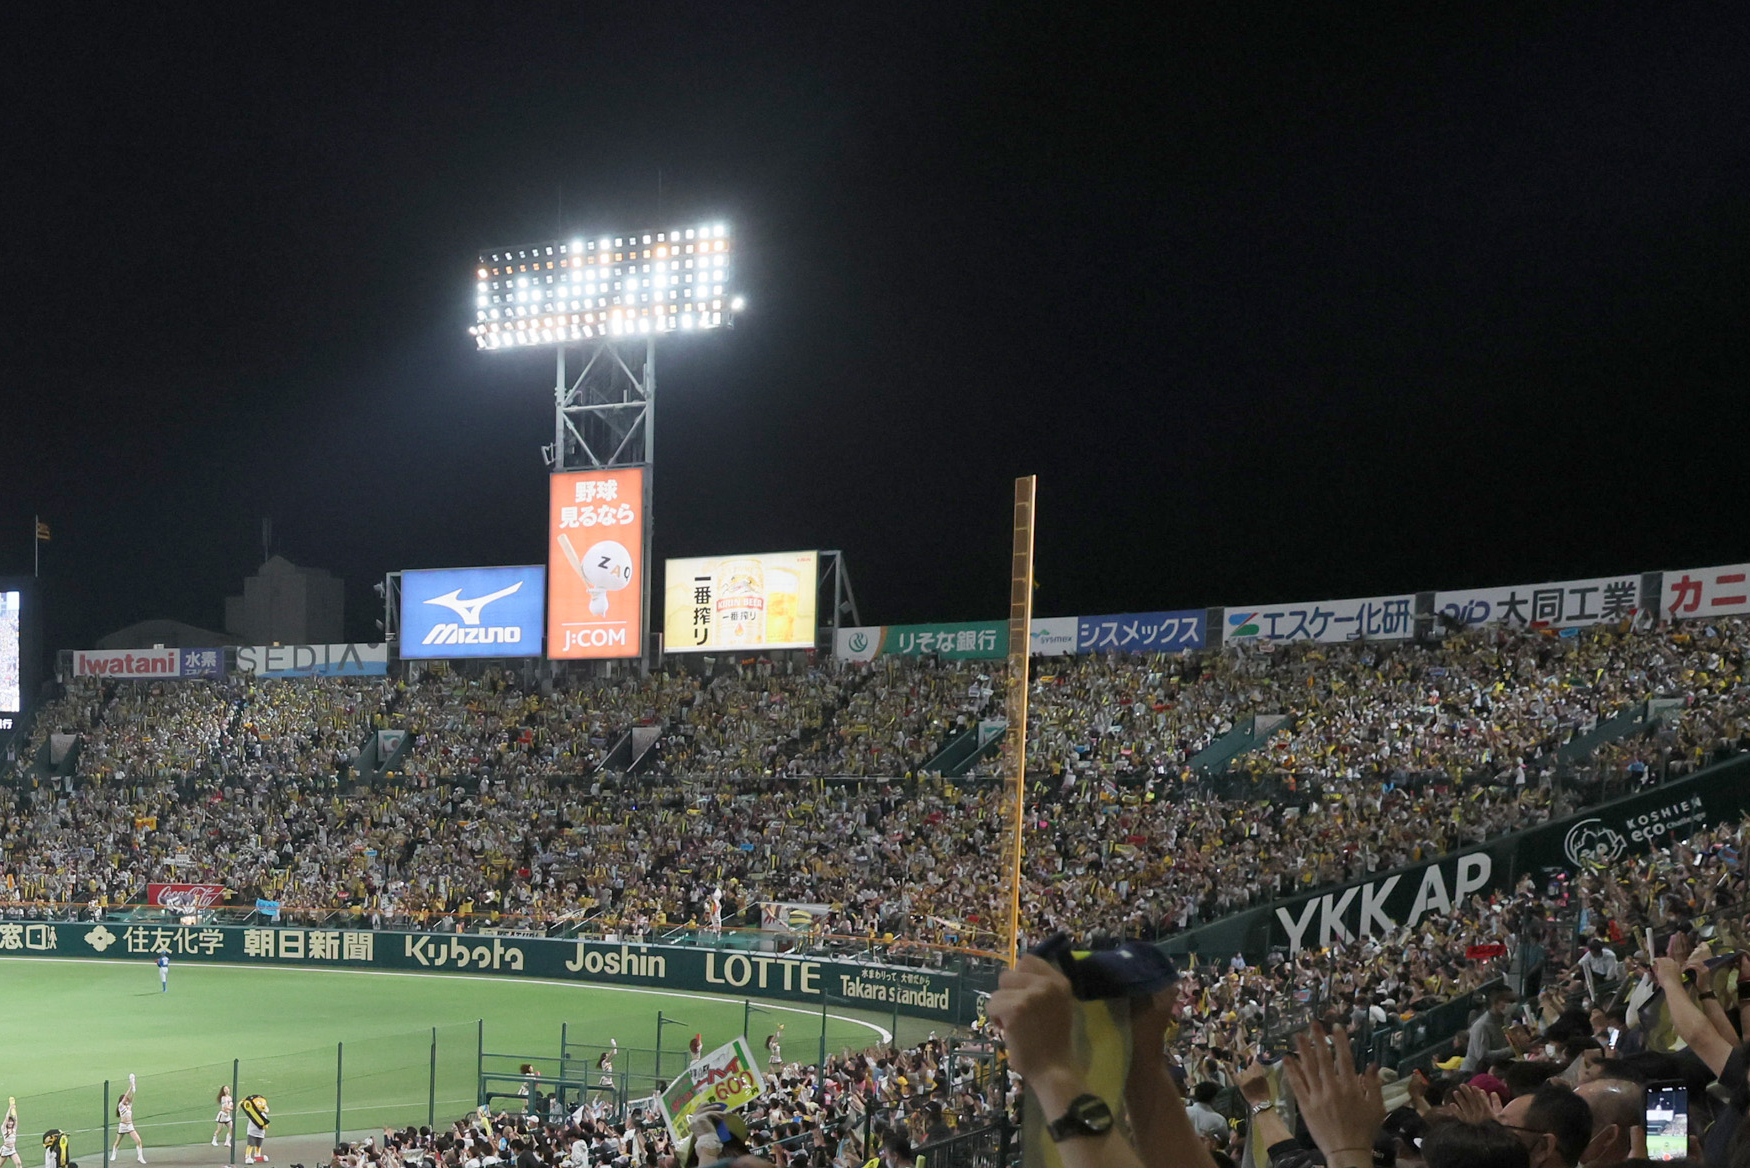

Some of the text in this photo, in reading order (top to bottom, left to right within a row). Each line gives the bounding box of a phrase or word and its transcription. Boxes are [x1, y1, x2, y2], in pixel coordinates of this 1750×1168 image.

[574, 479, 618, 503] 野球
[559, 502, 635, 528] 見るなら
[693, 576, 712, 646] 一番搾り
[718, 597, 763, 609] KIRIN BEER
[1497, 582, 1637, 624] 大同工業
[422, 623, 521, 645] MIZUNO
[1080, 616, 1200, 648] シスメックス
[1263, 600, 1410, 640] エスケー化研
[563, 628, 626, 651] J:COM
[899, 628, 997, 654] りそな銀行
[79, 653, 175, 675] Iwatani
[185, 652, 217, 668] 水素
[238, 645, 365, 673] SEDIA
[1626, 797, 1703, 829] KOSHIEN
[1631, 823, 1666, 843] eco
[1275, 851, 1492, 958] YKK AP
[123, 926, 224, 954] 住友化学
[243, 928, 374, 961] 朝日新聞
[405, 935, 524, 971] Kubota
[565, 942, 666, 978] Joshin
[705, 953, 821, 994] LOTTE
[840, 975, 887, 1001] Takara
